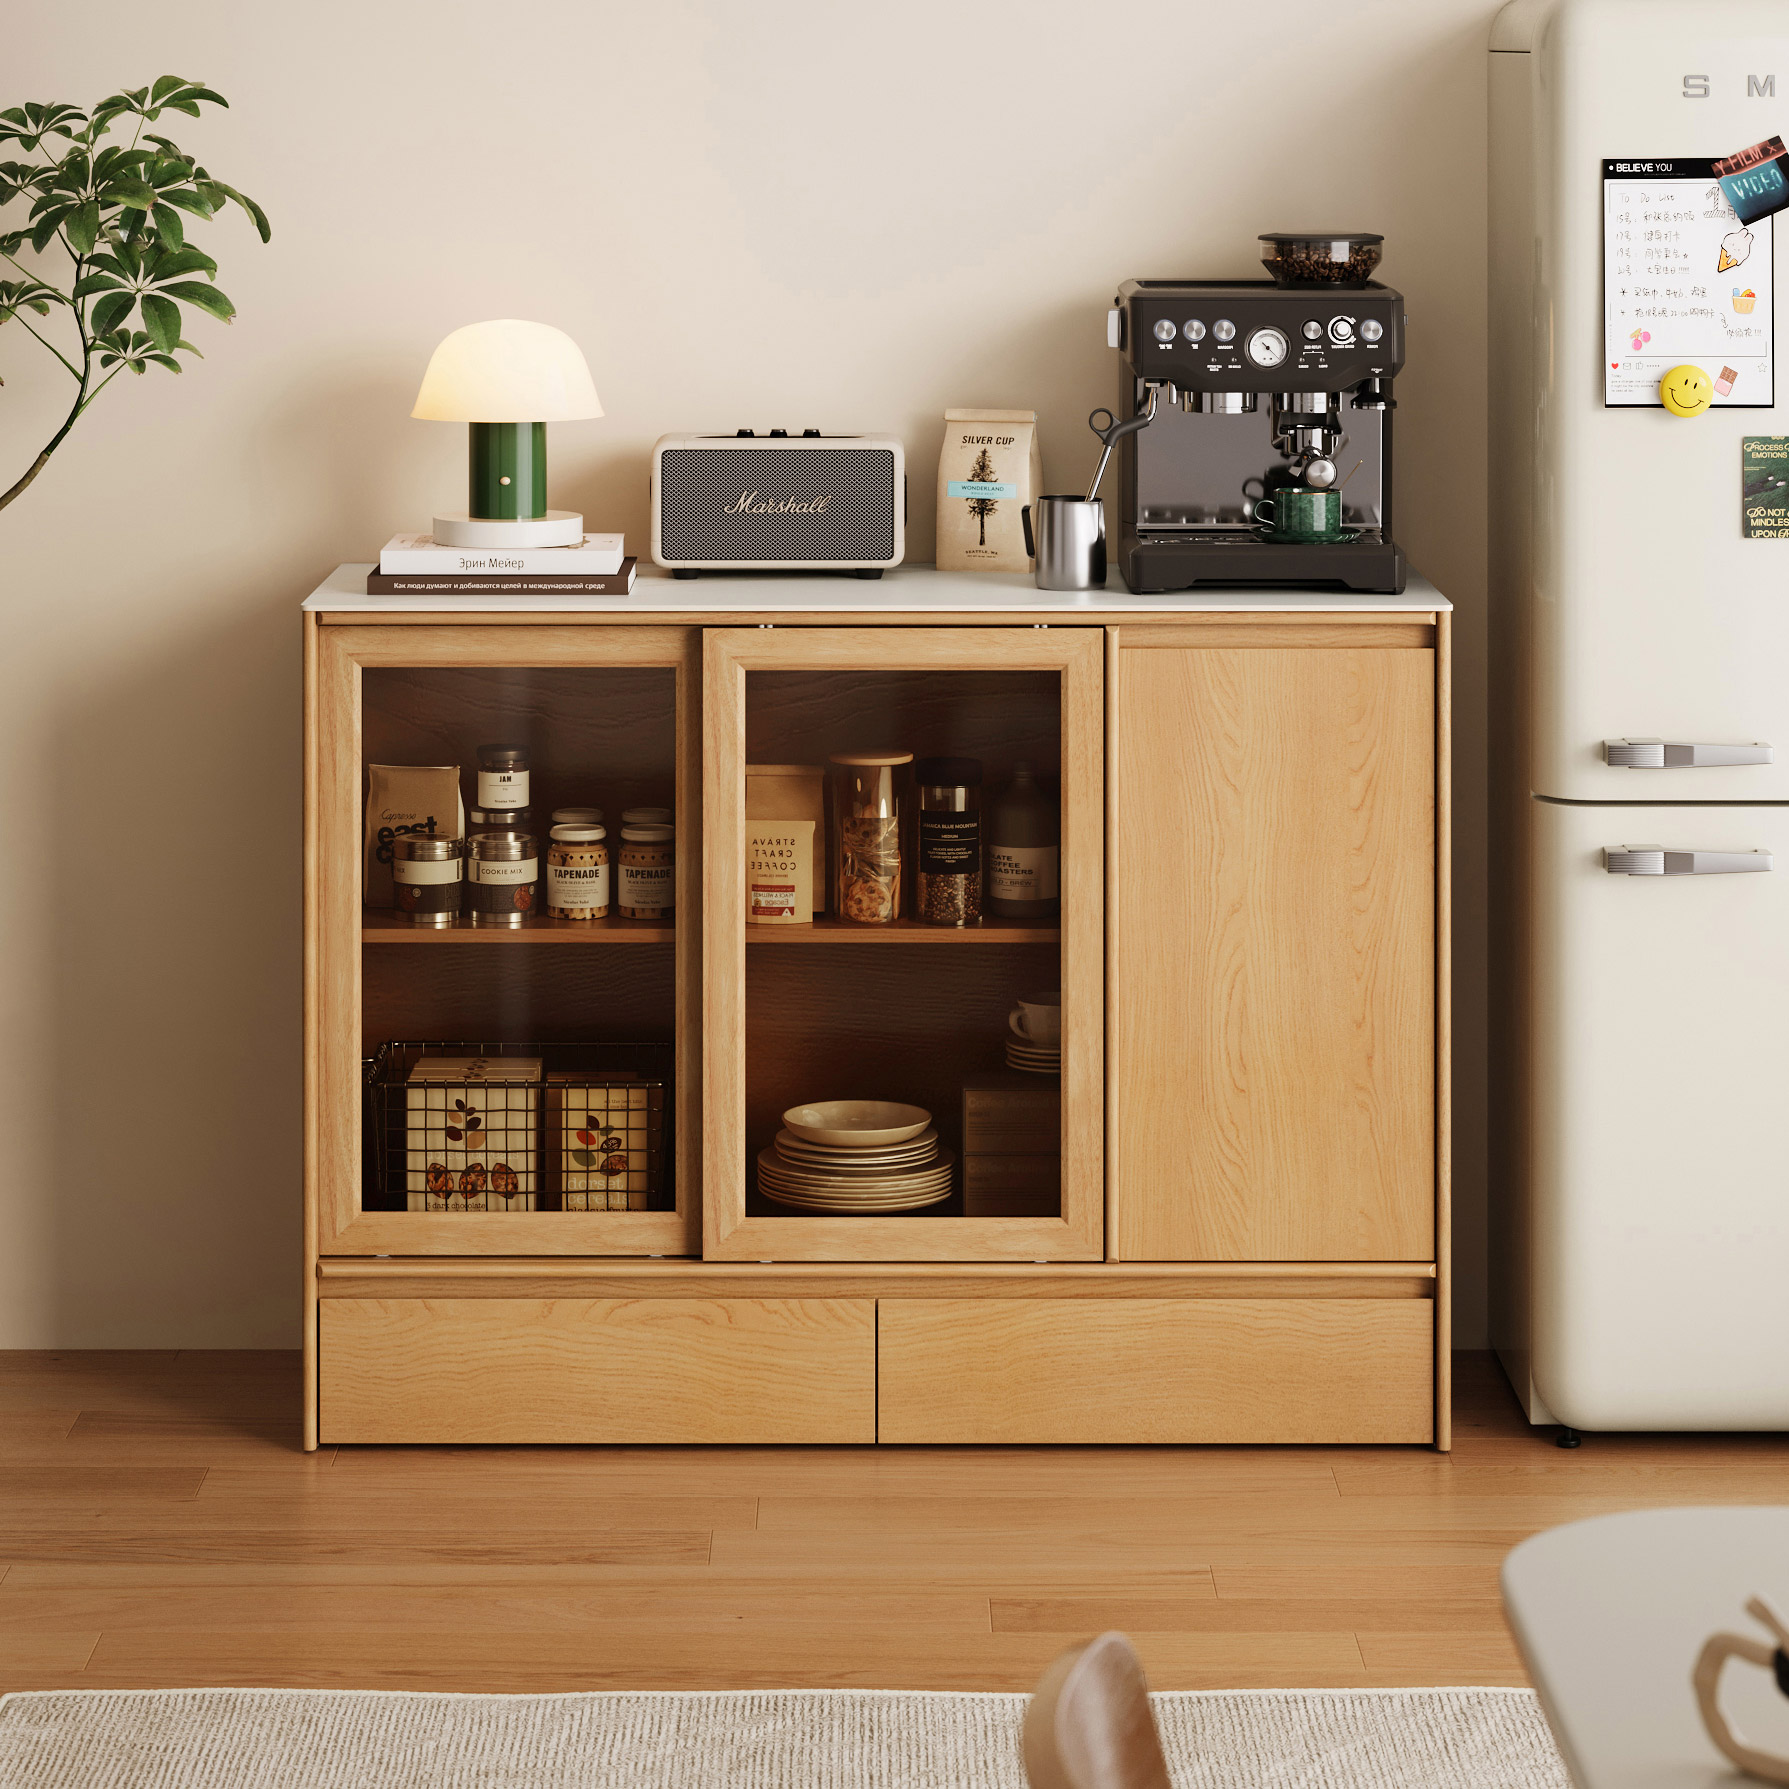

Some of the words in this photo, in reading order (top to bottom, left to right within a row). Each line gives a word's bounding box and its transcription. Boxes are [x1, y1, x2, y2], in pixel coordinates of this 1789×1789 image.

[1727, 145, 1764, 171] FILM
[1616, 163, 1654, 172] BELIEVE
[1655, 163, 1673, 172] YOU
[1731, 168, 1783, 200] VIDEO
[961, 435, 993, 445] SILVER
[995, 436, 1015, 445] CUP
[1744, 441, 1784, 452] PROCESS
[723, 489, 833, 514] Marshall
[1767, 508, 1786, 517] NOT
[1751, 529, 1777, 538] UPON
[459, 557, 486, 571] Эрин
[488, 556, 525, 571] Мейер
[459, 582, 500, 590] добиваются
[500, 582, 522, 590] целей
[528, 582, 584, 590] международной
[499, 775, 512, 783] JAM
[553, 868, 600, 879] TAPENADE
[625, 868, 672, 879] TAPENADE
[567, 1177, 624, 1190] dorset
[567, 1191, 628, 1205] cereals
